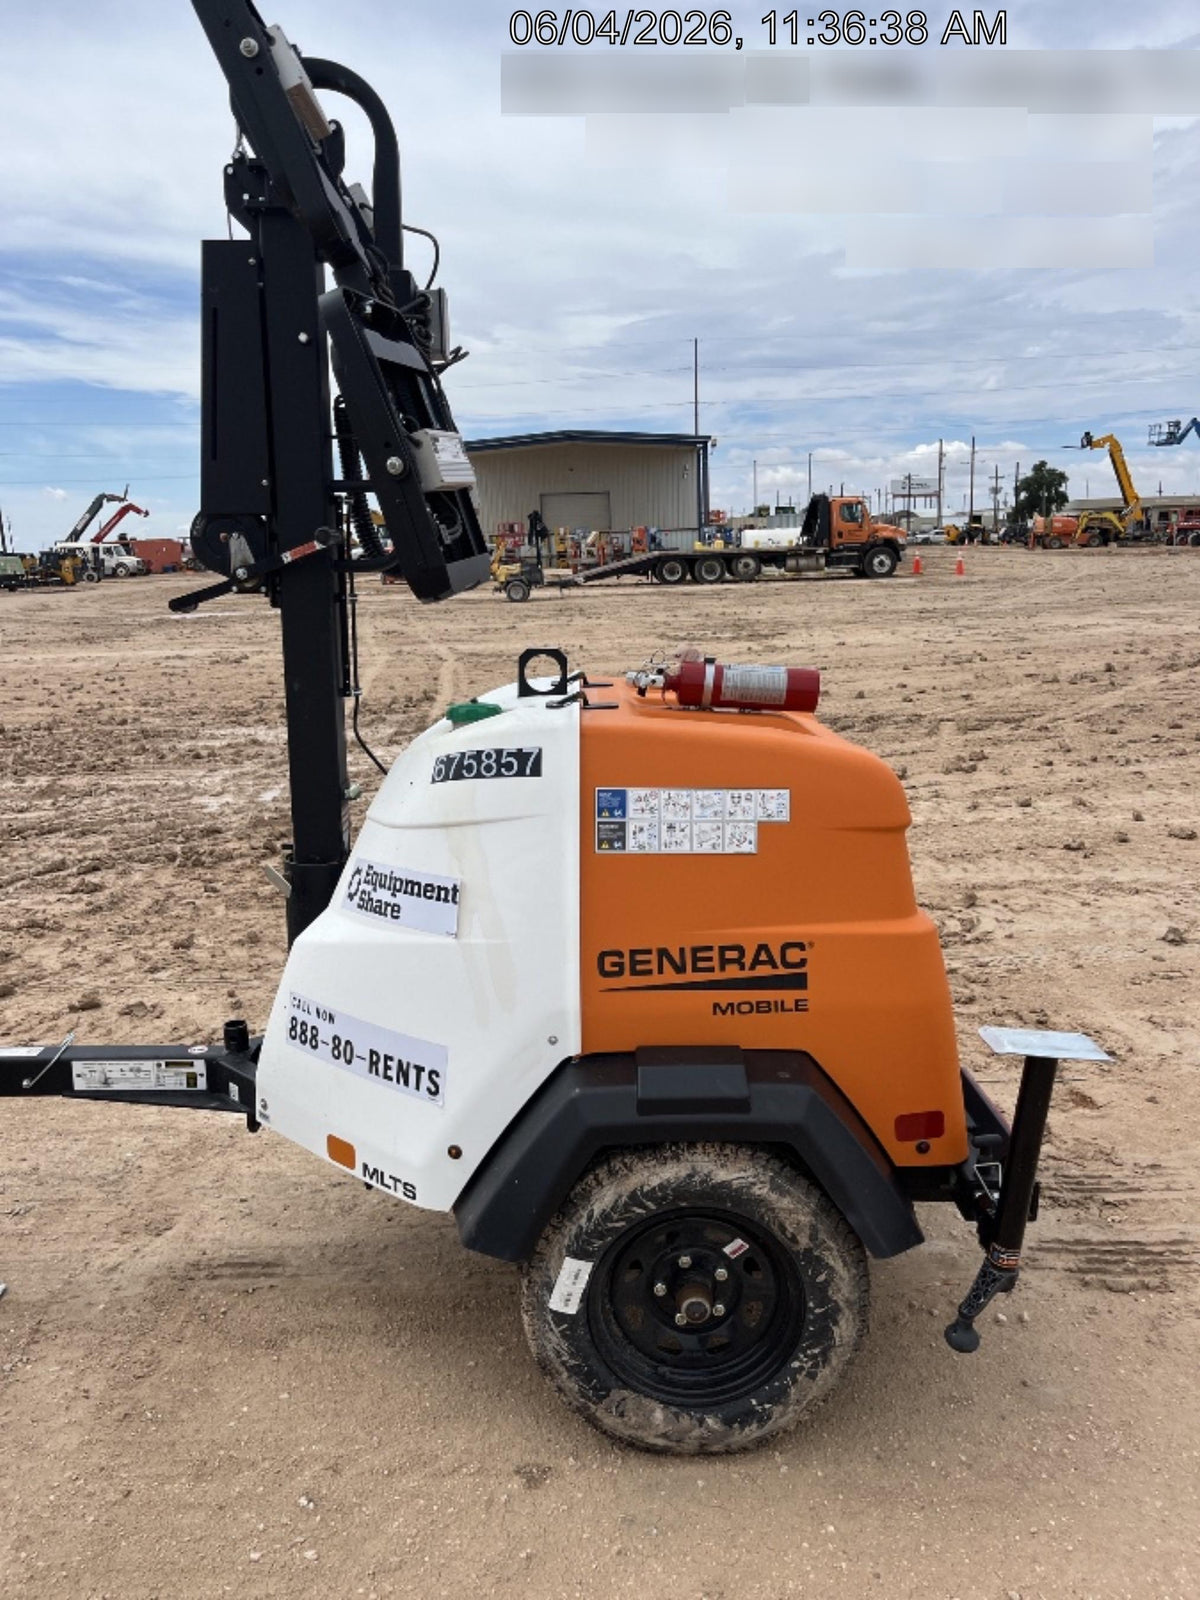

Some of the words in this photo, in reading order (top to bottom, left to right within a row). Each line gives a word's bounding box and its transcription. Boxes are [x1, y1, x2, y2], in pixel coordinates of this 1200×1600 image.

[432, 747, 540, 781] 675857
[363, 864, 460, 905] Equipment
[357, 888, 401, 920] Share
[596, 941, 808, 979] GENERAC
[292, 996, 312, 1016] CALL
[316, 1006, 336, 1025] NOW
[712, 999, 809, 1016] MOBILE
[289, 1016, 440, 1096] 888-80-RENTS
[362, 1162, 416, 1200] MLTS
